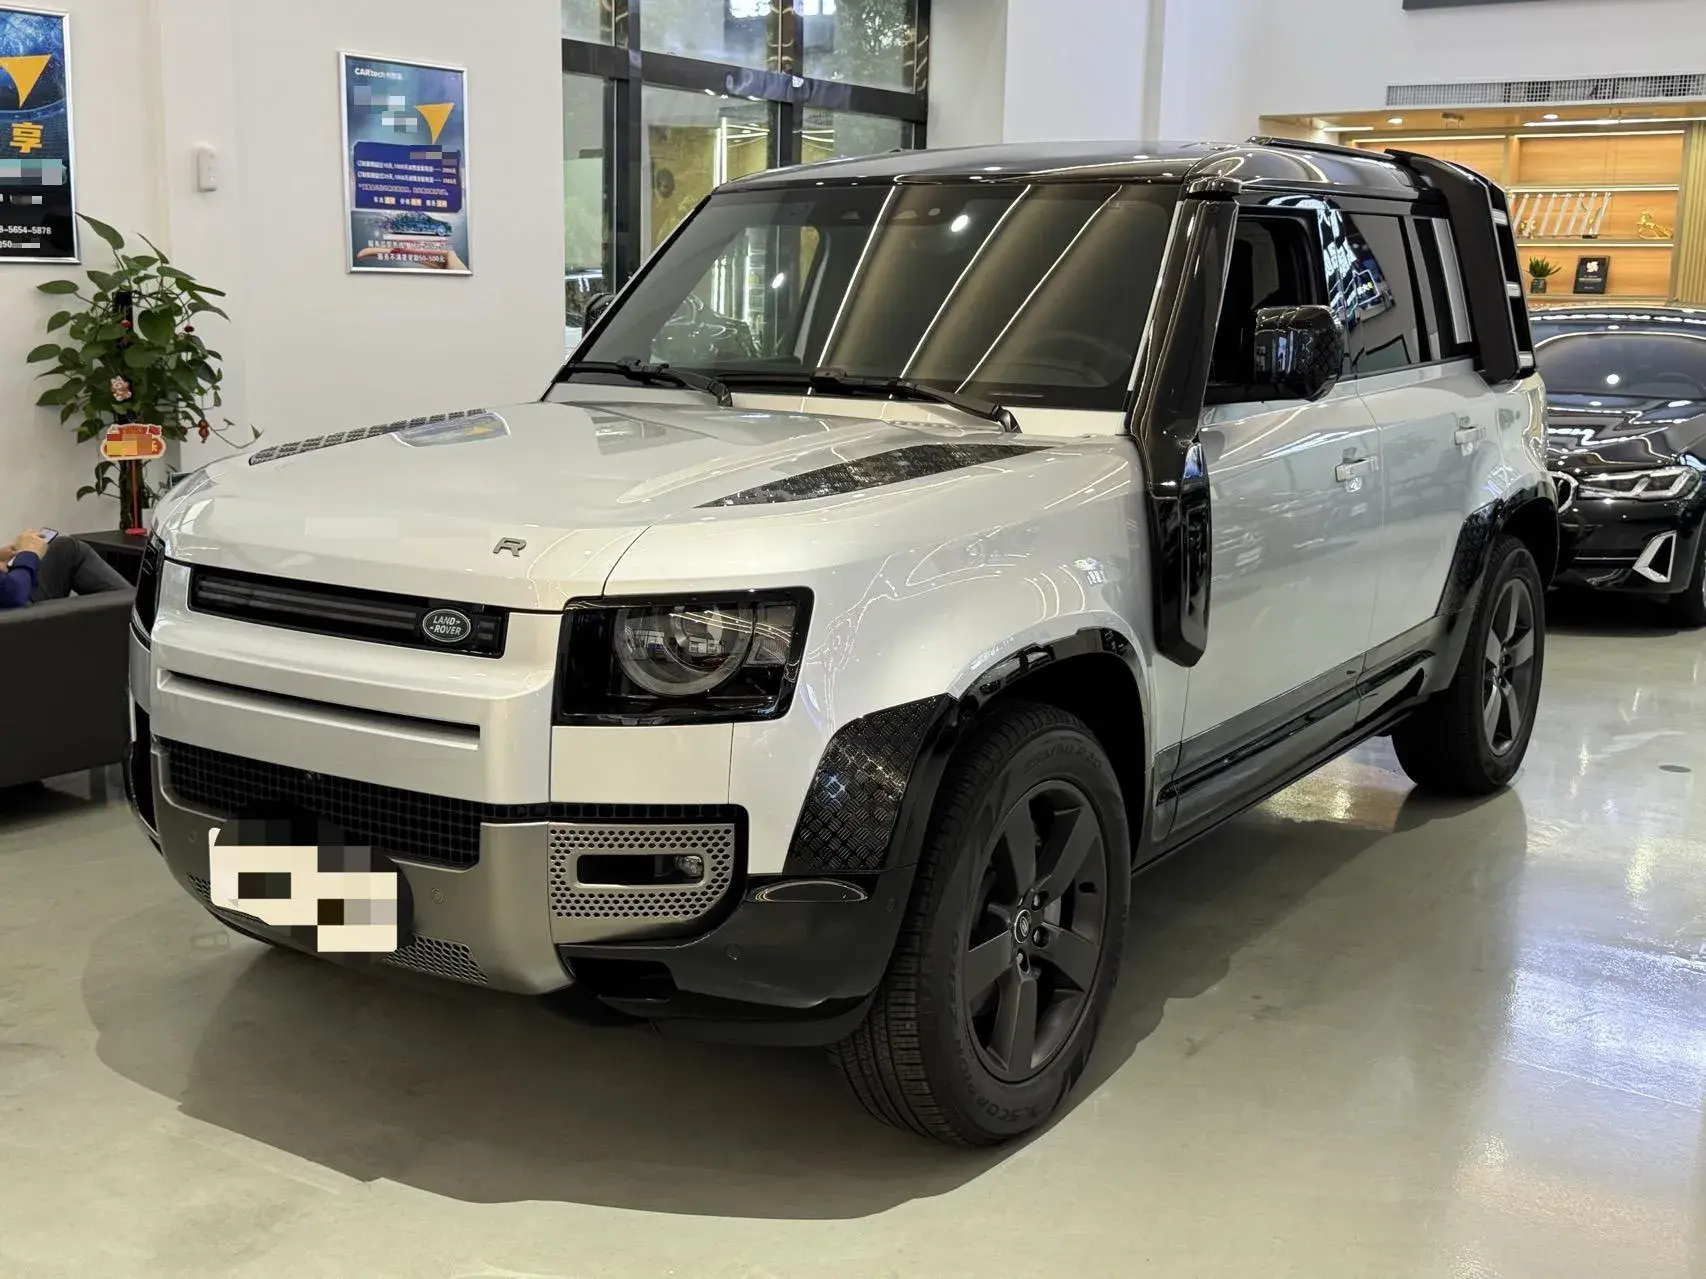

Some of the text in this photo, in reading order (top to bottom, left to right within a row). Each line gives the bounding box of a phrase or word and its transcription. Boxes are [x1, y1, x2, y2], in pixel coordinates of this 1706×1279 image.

[10, 121, 44, 154] 享
[493, 537, 527, 557] R
[433, 624, 462, 636] ROVER
